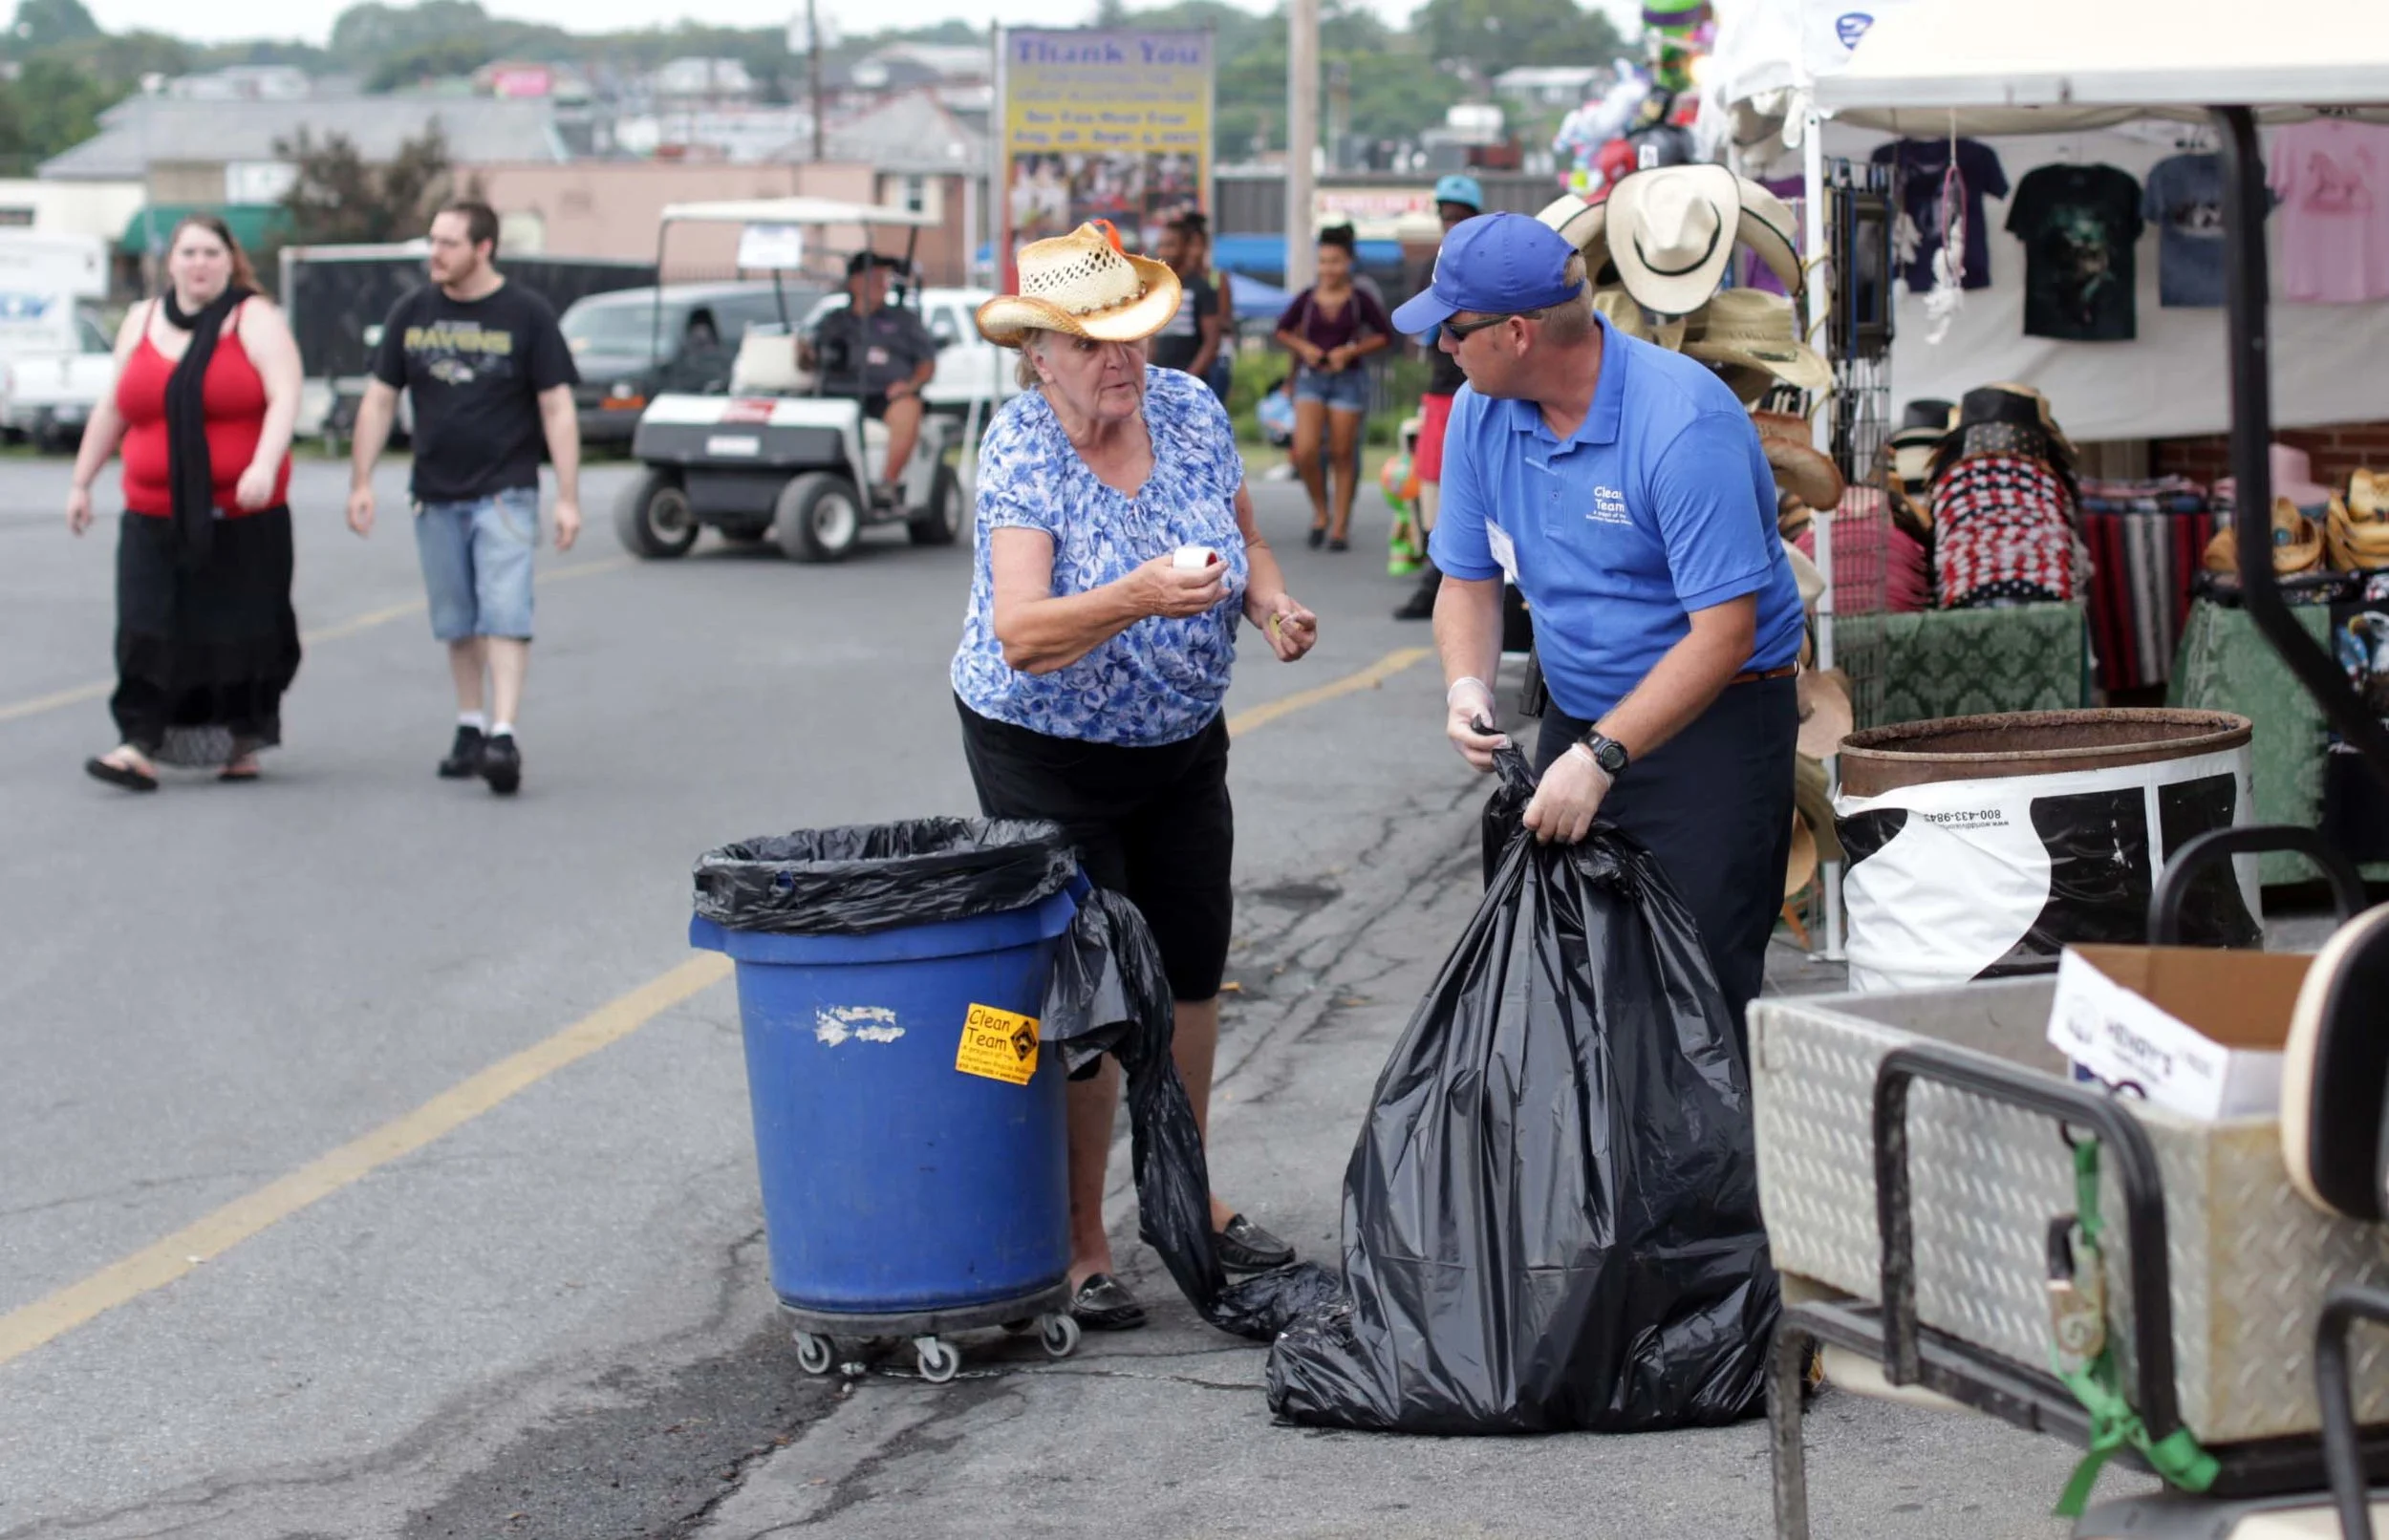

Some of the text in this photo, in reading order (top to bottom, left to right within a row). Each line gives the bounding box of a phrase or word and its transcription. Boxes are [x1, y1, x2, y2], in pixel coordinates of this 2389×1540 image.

[1018, 39, 1199, 64] Thank You
[403, 326, 513, 355] RAVENS
[1595, 498, 1625, 513] Team
[969, 1009, 1011, 1032] Clean
[967, 1026, 1007, 1051] Team
